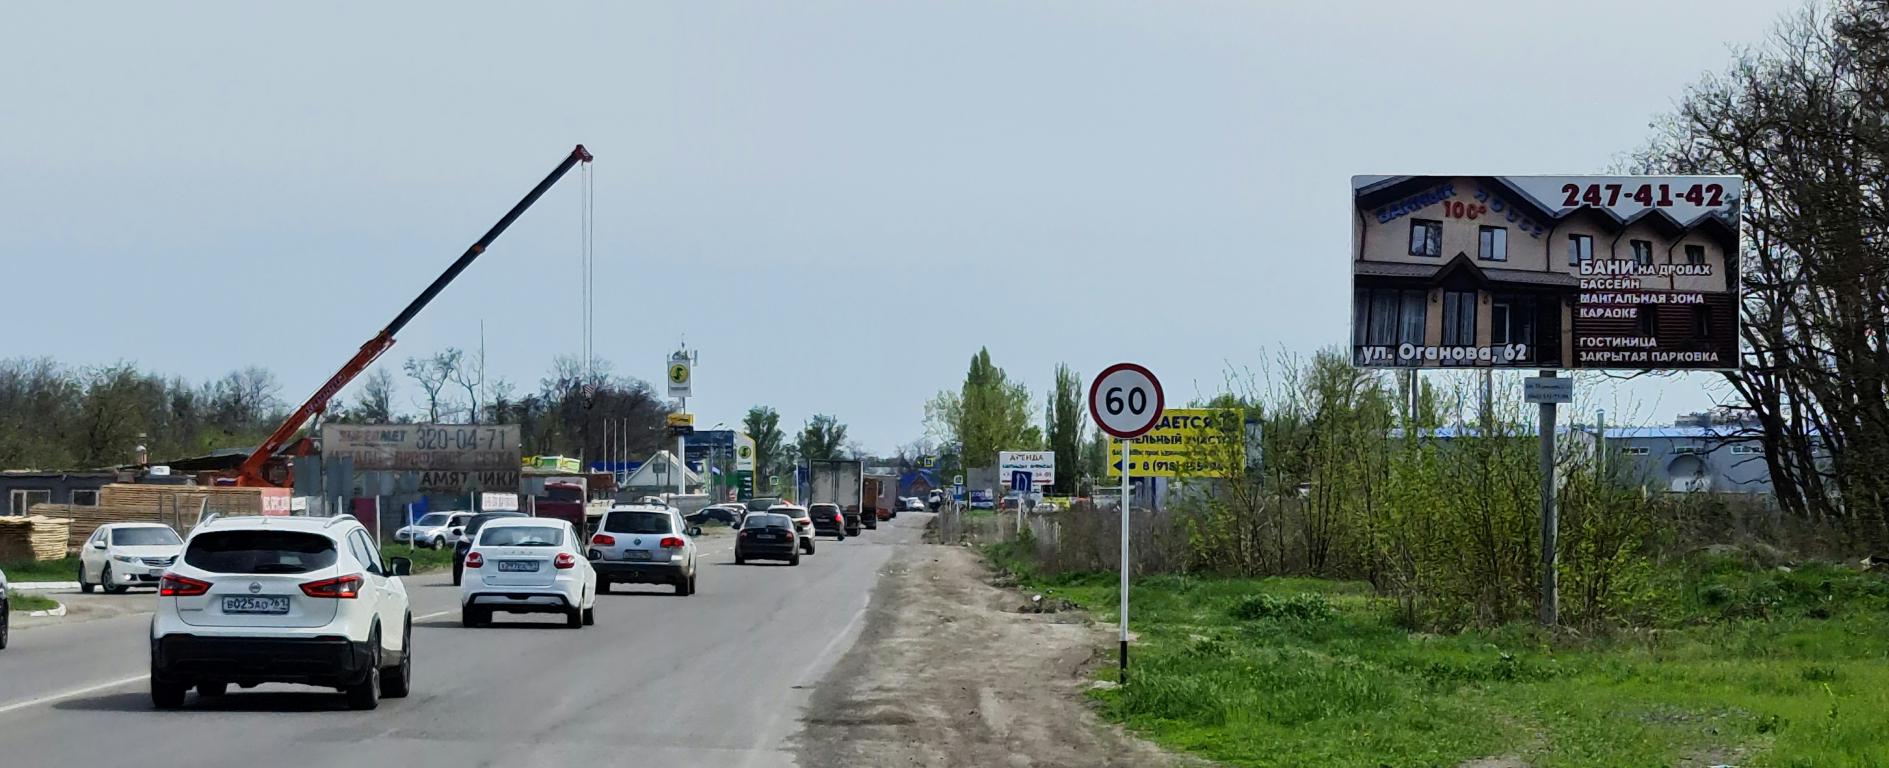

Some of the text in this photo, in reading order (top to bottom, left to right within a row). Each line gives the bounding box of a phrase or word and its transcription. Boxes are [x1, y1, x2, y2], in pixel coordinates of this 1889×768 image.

[1561, 183, 1724, 207] 247-41-42
[1580, 260, 1712, 277] БАНИ НА ДРОВАХ
[1580, 278, 1640, 289] БАССЕЙН
[1580, 293, 1704, 304] МАНГАЛЬНАЯ ЗОНА
[1580, 308, 1637, 318] КАРАОКЕ
[1580, 337, 1657, 348] ГОСТИНИЦА
[1362, 343, 1527, 365] ул. Оганова, 62
[1580, 352, 1719, 362] ЗАКРЫТАЯ ПАРКОВКА
[1105, 387, 1147, 415] 60
[1155, 415, 1214, 431] АЕТСЯ
[416, 428, 506, 450] 320-04-71
[417, 471, 520, 487] АМЯТИКИ
